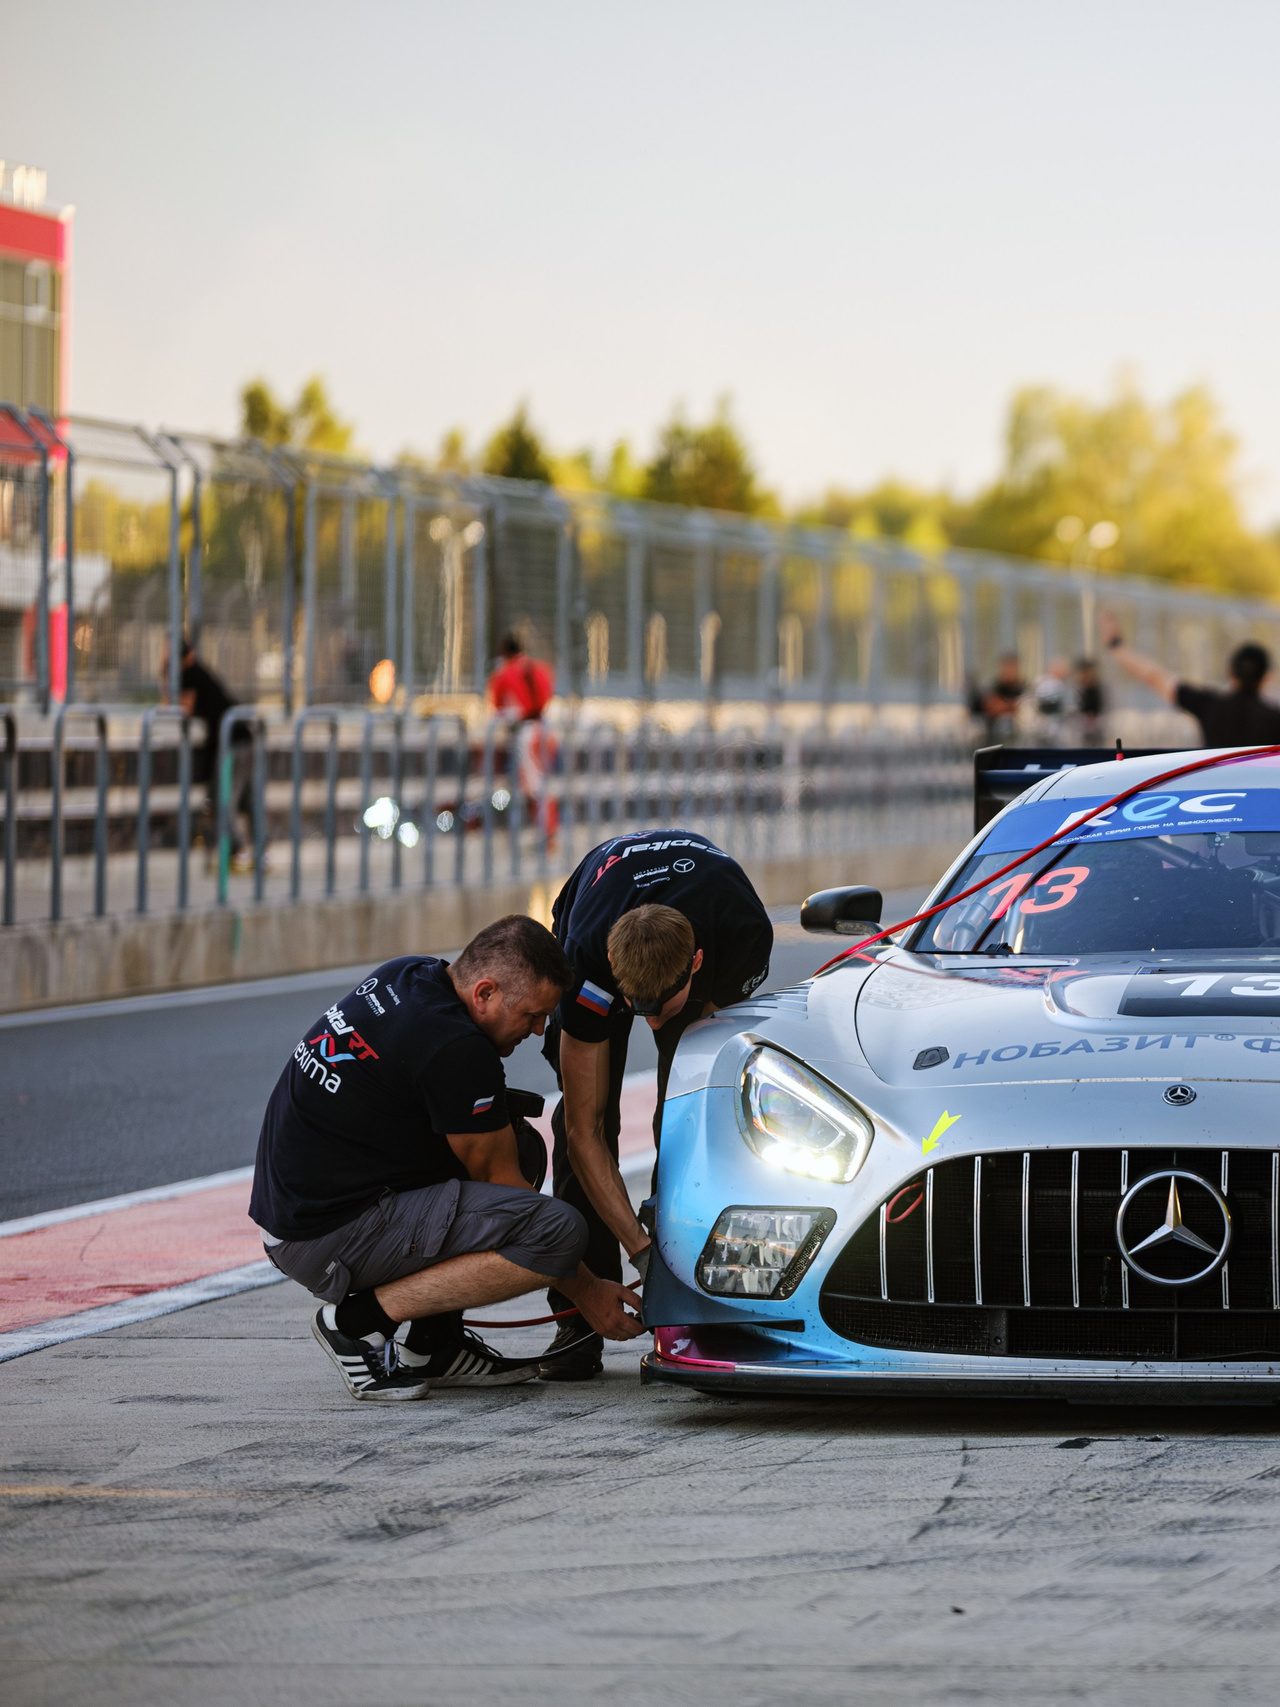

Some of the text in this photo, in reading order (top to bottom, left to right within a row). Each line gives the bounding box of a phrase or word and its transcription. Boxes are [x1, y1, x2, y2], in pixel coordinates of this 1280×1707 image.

[1133, 823, 1160, 831] ГОНОК
[987, 866, 1091, 920] 13
[292, 1039, 342, 1094] exima
